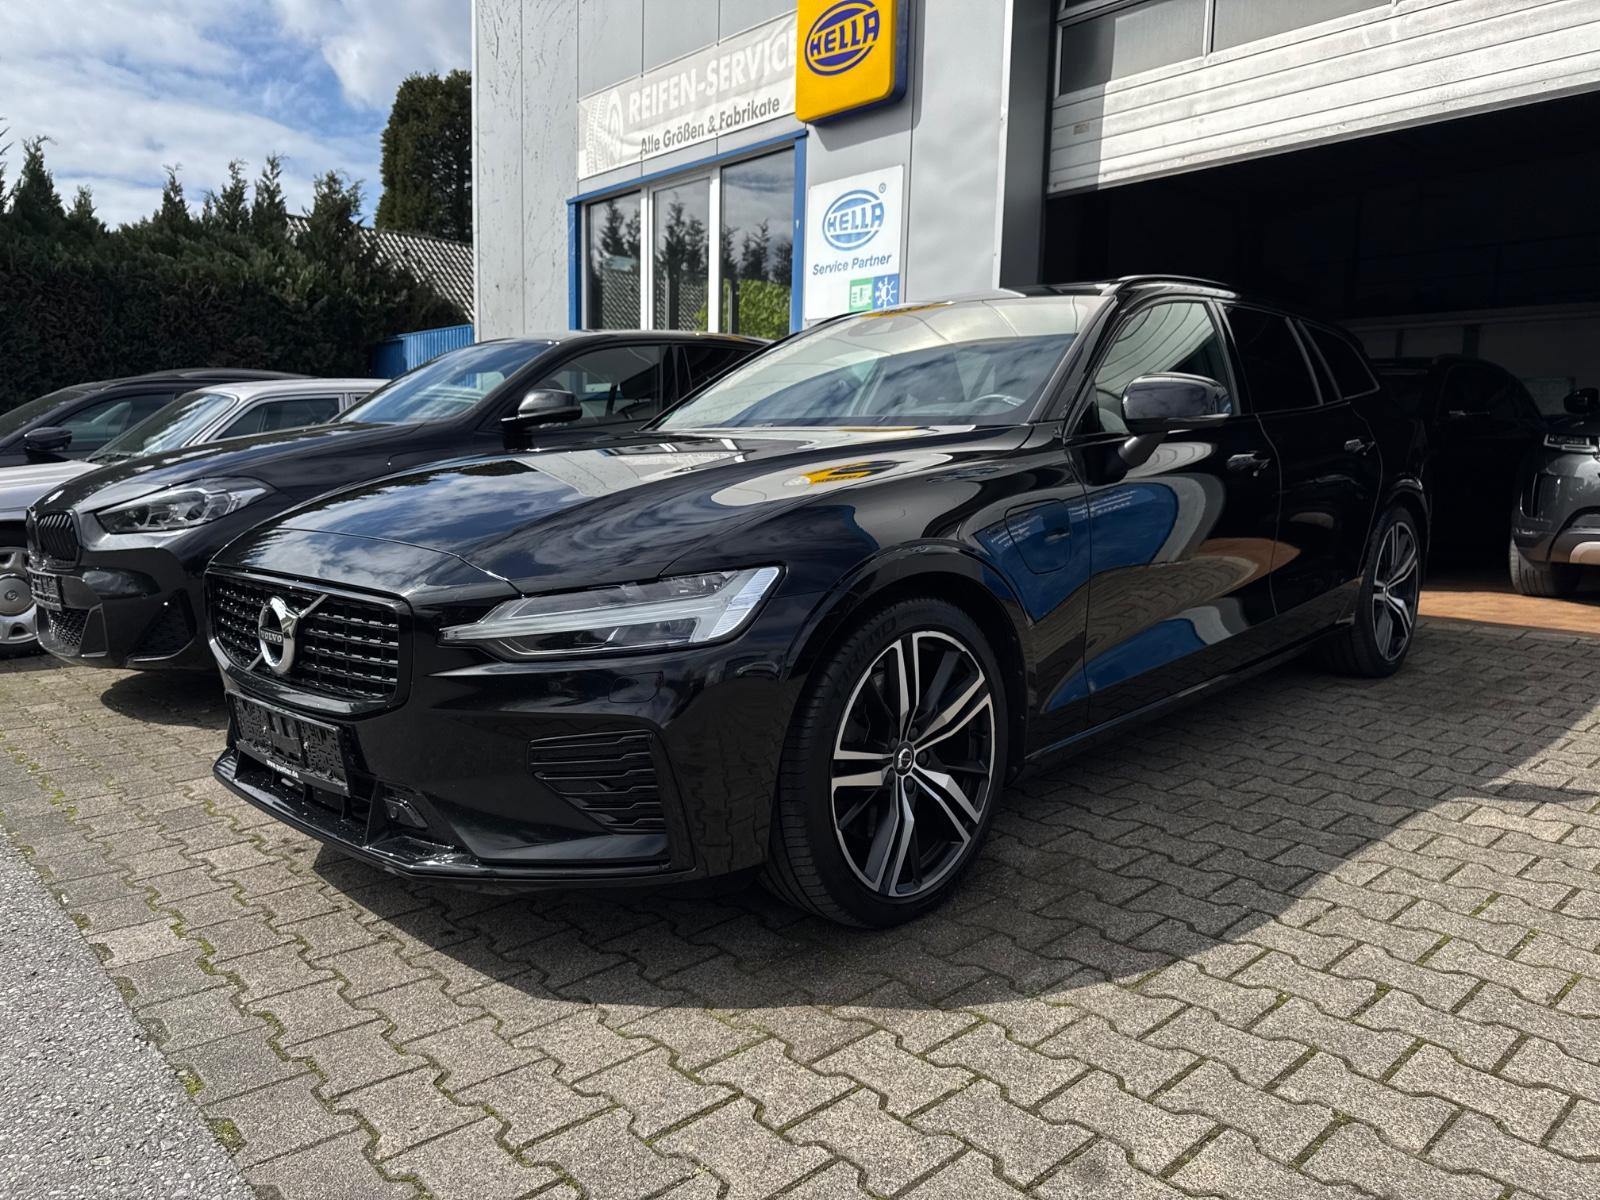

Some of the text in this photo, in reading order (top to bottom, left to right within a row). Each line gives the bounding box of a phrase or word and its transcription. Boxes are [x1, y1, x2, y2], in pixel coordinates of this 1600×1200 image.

[809, 10, 880, 57] HELLA
[640, 97, 780, 155] Alle Größen & Fabrikate
[827, 202, 885, 233] HELLA
[812, 254, 892, 276] Service Partner
[260, 629, 283, 643] VOLVO
